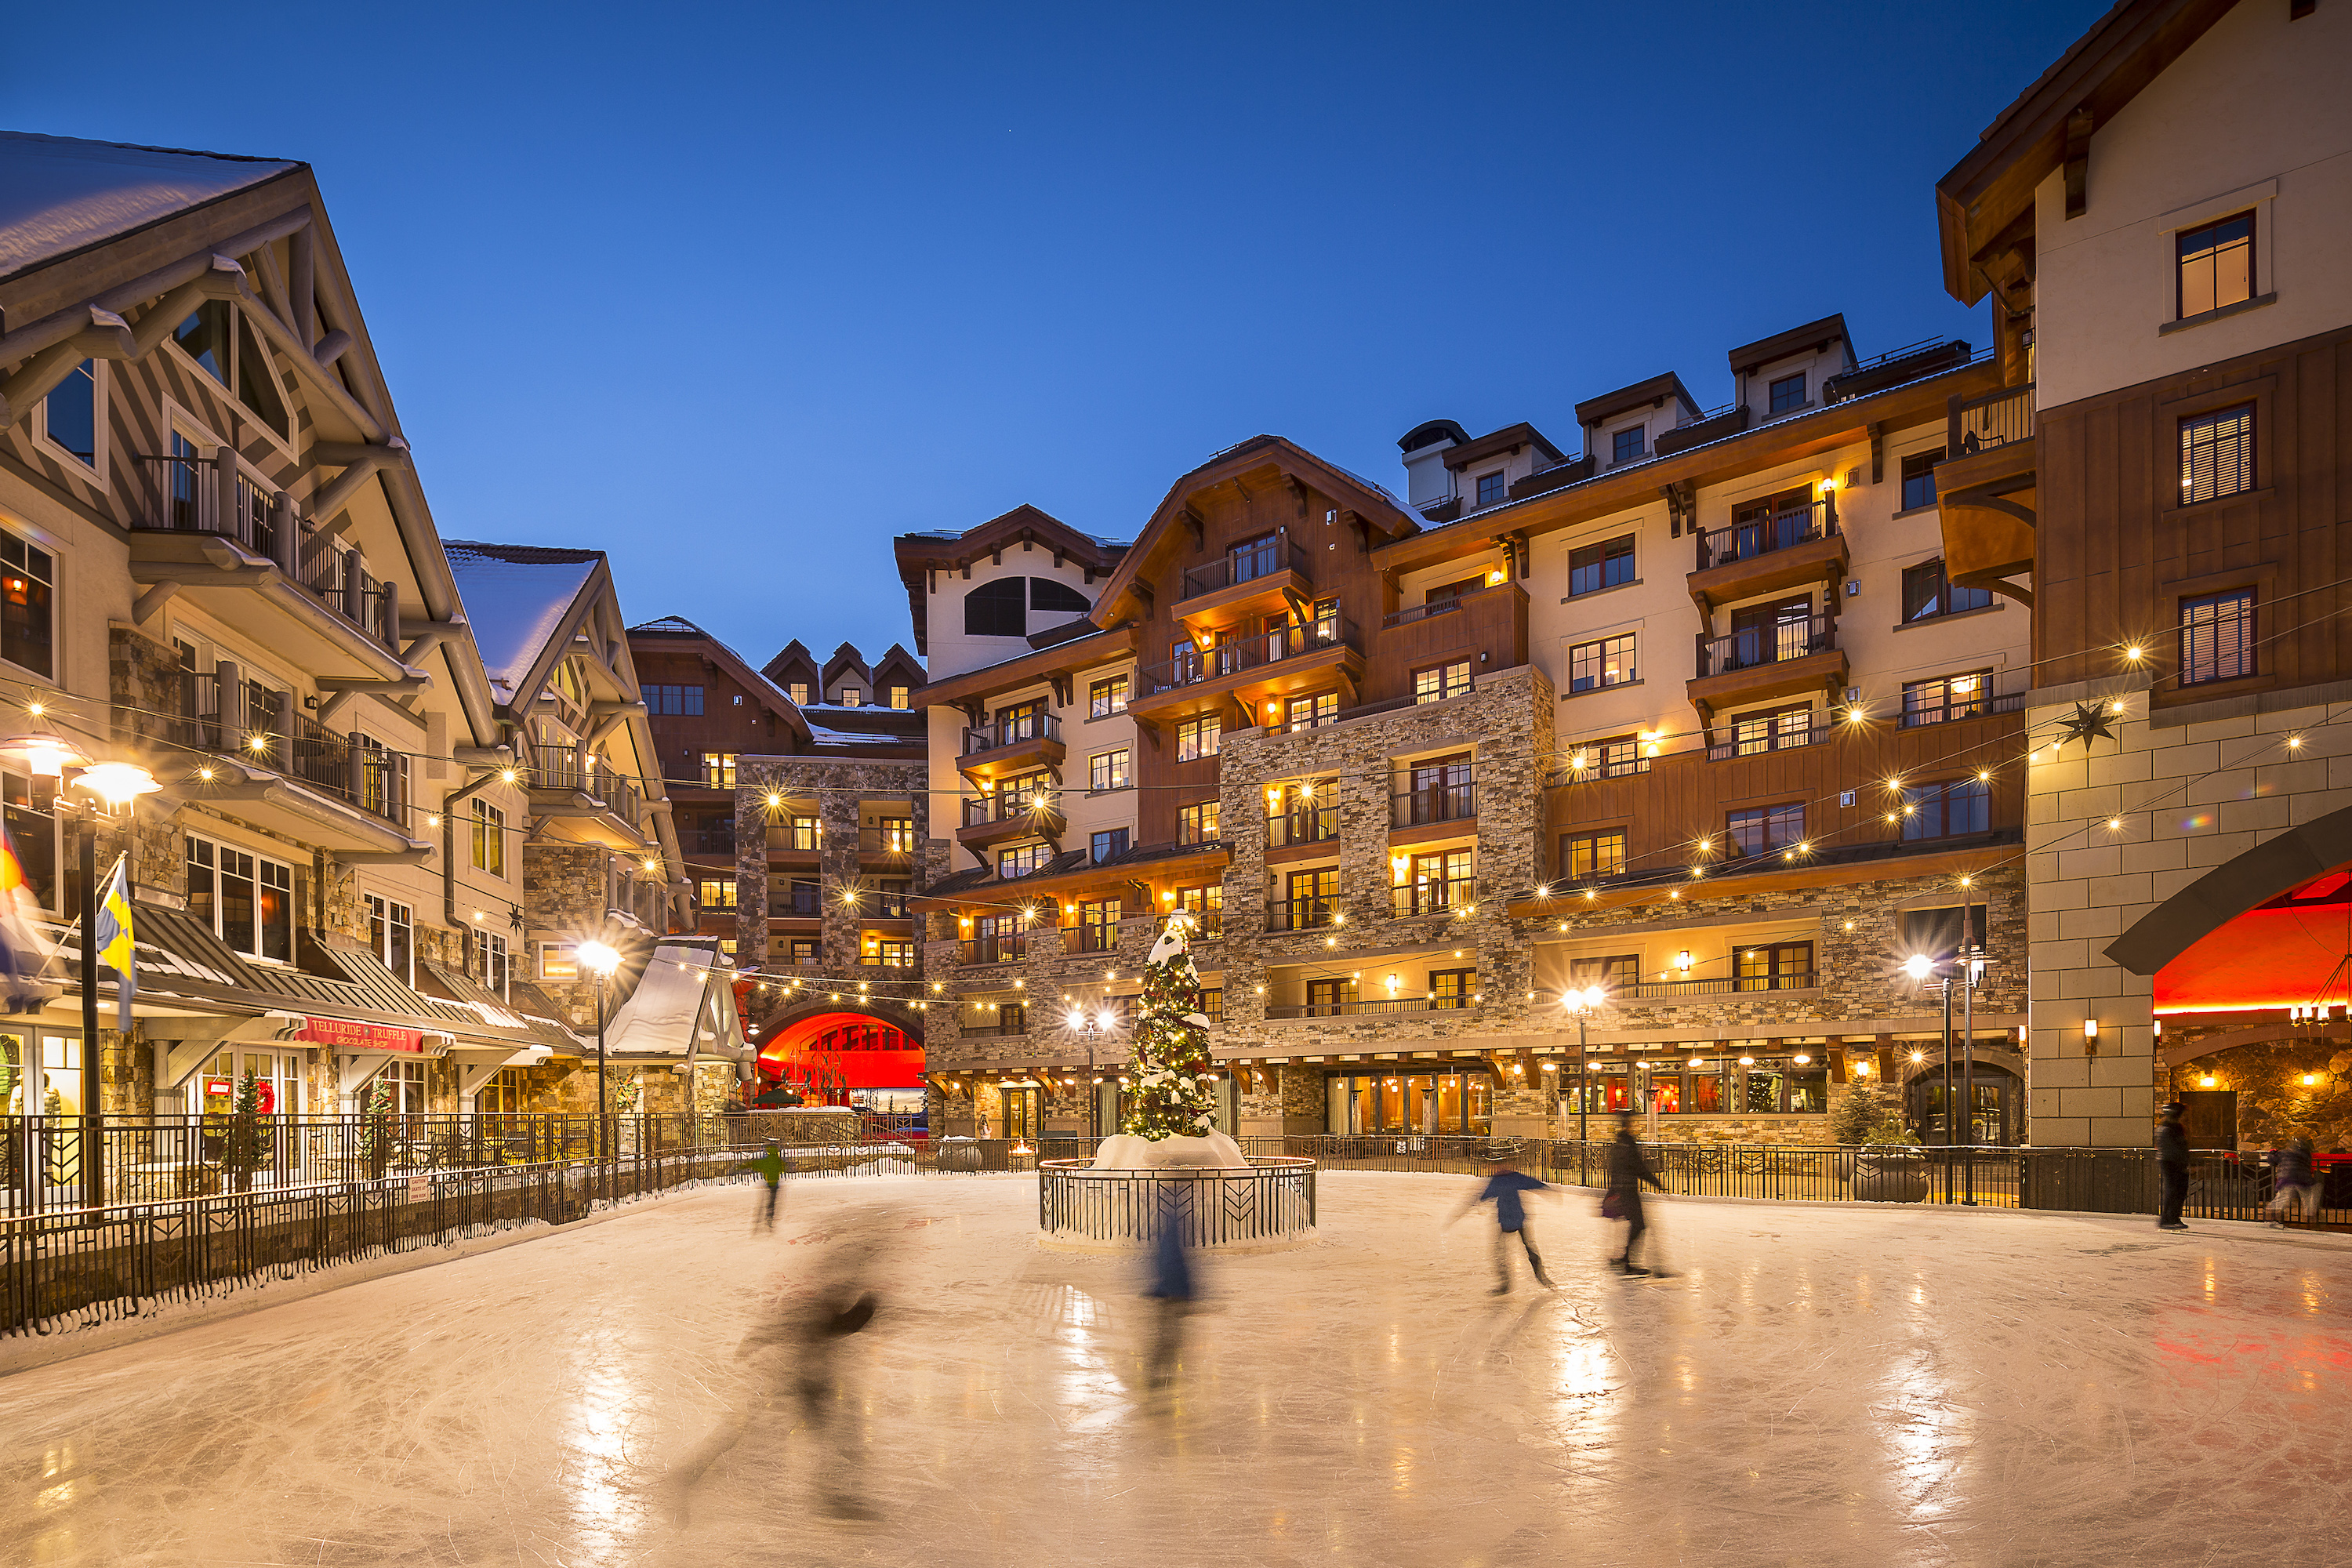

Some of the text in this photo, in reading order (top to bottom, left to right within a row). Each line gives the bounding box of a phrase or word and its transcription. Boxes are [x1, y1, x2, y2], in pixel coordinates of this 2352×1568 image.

[312, 1020, 406, 1040] TELLURIDE TRUFFLE
[336, 1036, 372, 1047] CHOCOLATE
